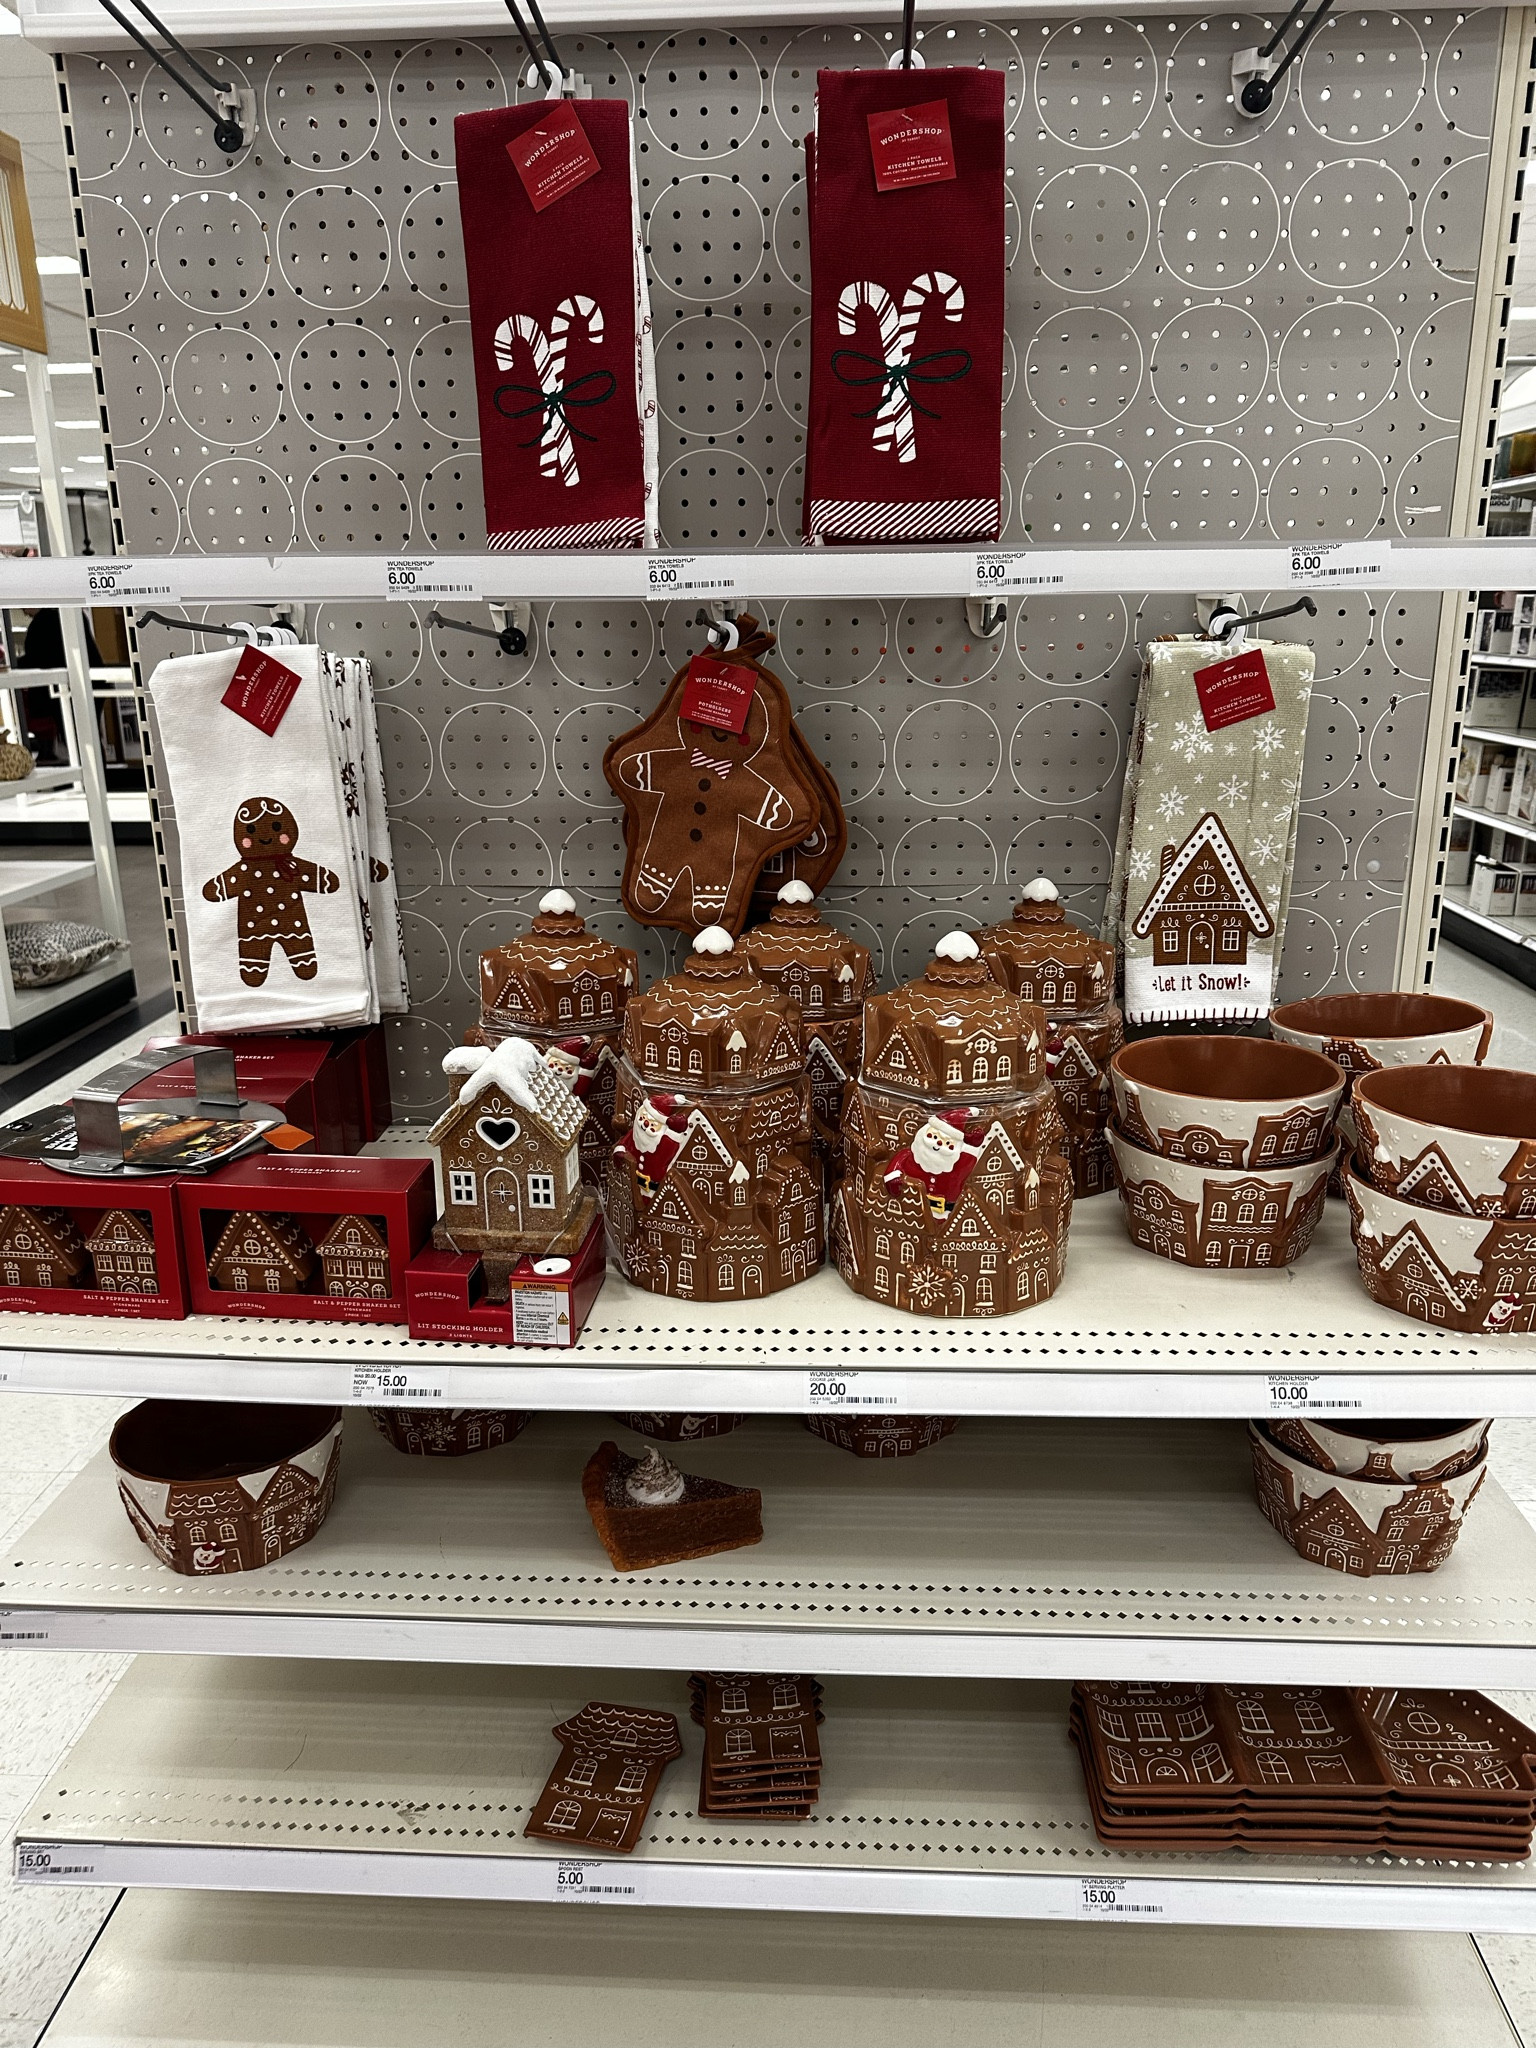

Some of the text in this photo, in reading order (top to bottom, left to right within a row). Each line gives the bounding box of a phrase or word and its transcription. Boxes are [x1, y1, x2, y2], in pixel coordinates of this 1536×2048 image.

[880, 128, 942, 146] WONDERSHOP
[524, 130, 576, 167] WONDERSHOP
[888, 156, 942, 170] KITCHEN TOWELS
[538, 171, 561, 188] KITCHEN
[562, 155, 579, 172] TOWELS
[1292, 544, 1343, 552] WONDERSHOP
[977, 552, 1026, 560] WONDERSHOP
[1292, 556, 1321, 571] 6.00
[388, 572, 416, 584] 6.00
[649, 570, 677, 583] 6.00
[977, 565, 1005, 579] 6.00
[89, 576, 115, 589] 6.00
[241, 661, 267, 708] WONDERSHOP
[695, 678, 746, 695] WONDERSHOP
[1206, 672, 1259, 694] WONDERSHOP
[260, 696, 273, 718] KITCHEN
[1214, 694, 1261, 713] KITCHEN TOWELS
[1182, 976, 1192, 991] it
[1199, 973, 1242, 990] Snow!
[415, 1292, 460, 1300] WONDERSHOP
[377, 1375, 407, 1387] 15.00
[810, 1383, 846, 1396] 20.00
[1271, 1386, 1308, 1400] 10.00
[20, 1854, 51, 1867] 15.00
[558, 1872, 583, 1884] 5.00
[1083, 1890, 1116, 1903] 15.00
